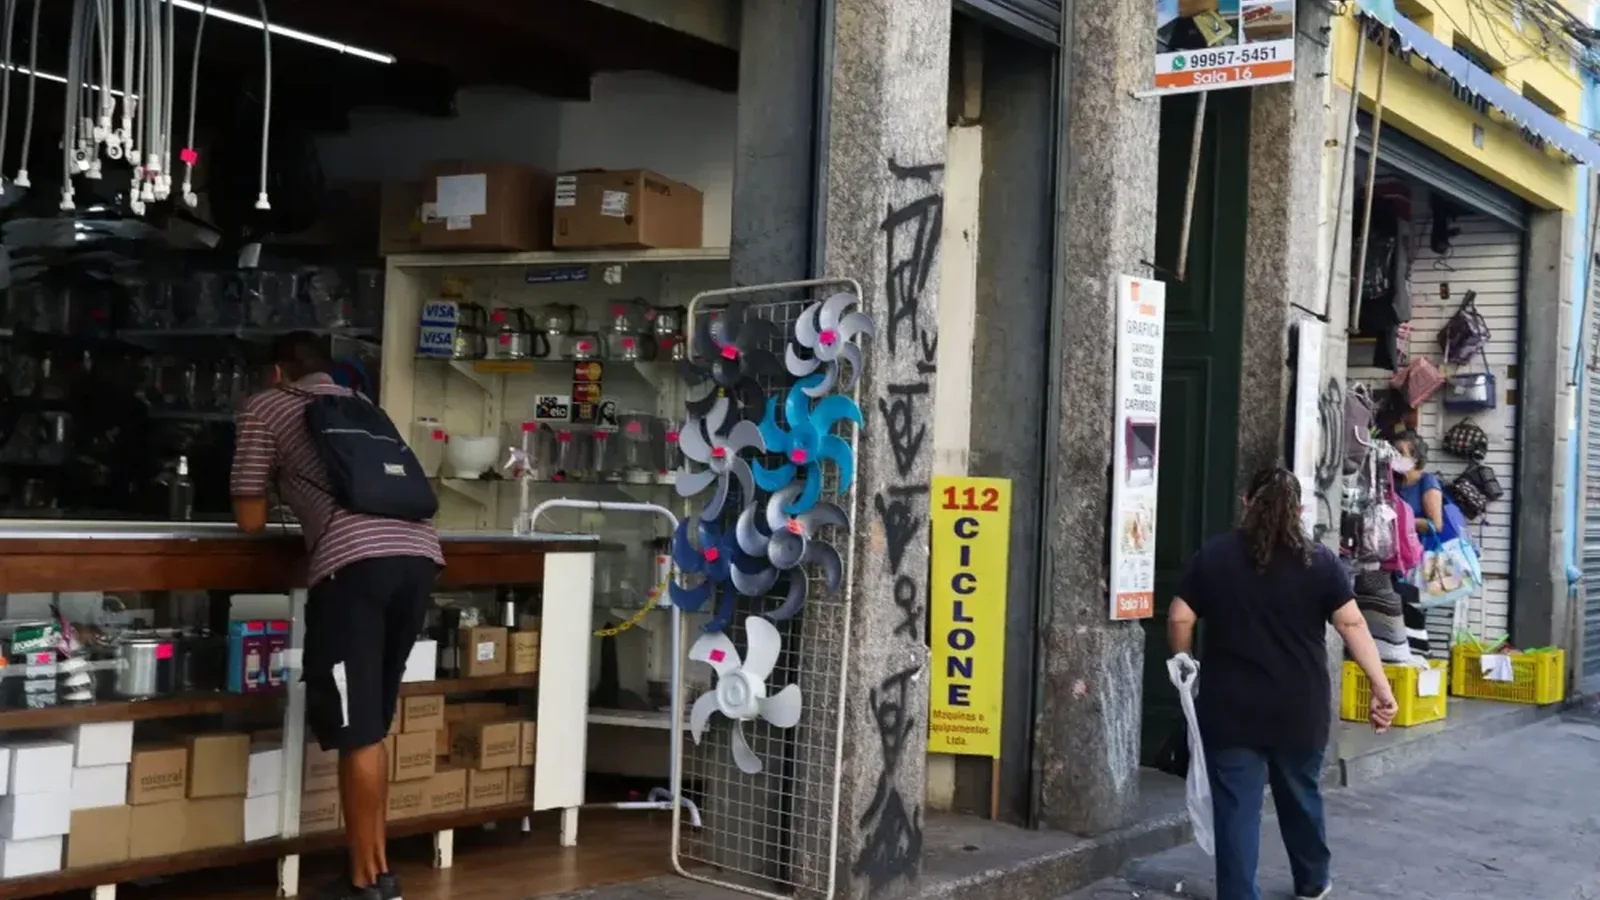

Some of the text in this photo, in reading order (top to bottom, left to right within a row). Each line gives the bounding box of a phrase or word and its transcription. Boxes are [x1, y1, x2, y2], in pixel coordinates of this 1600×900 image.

[1190, 46, 1276, 68] 99957-5451
[1193, 66, 1253, 85] Sala 16
[426, 303, 456, 318] VISA
[423, 331, 452, 345] VISA
[942, 486, 999, 512] 112
[947, 516, 980, 707] CICLONE
